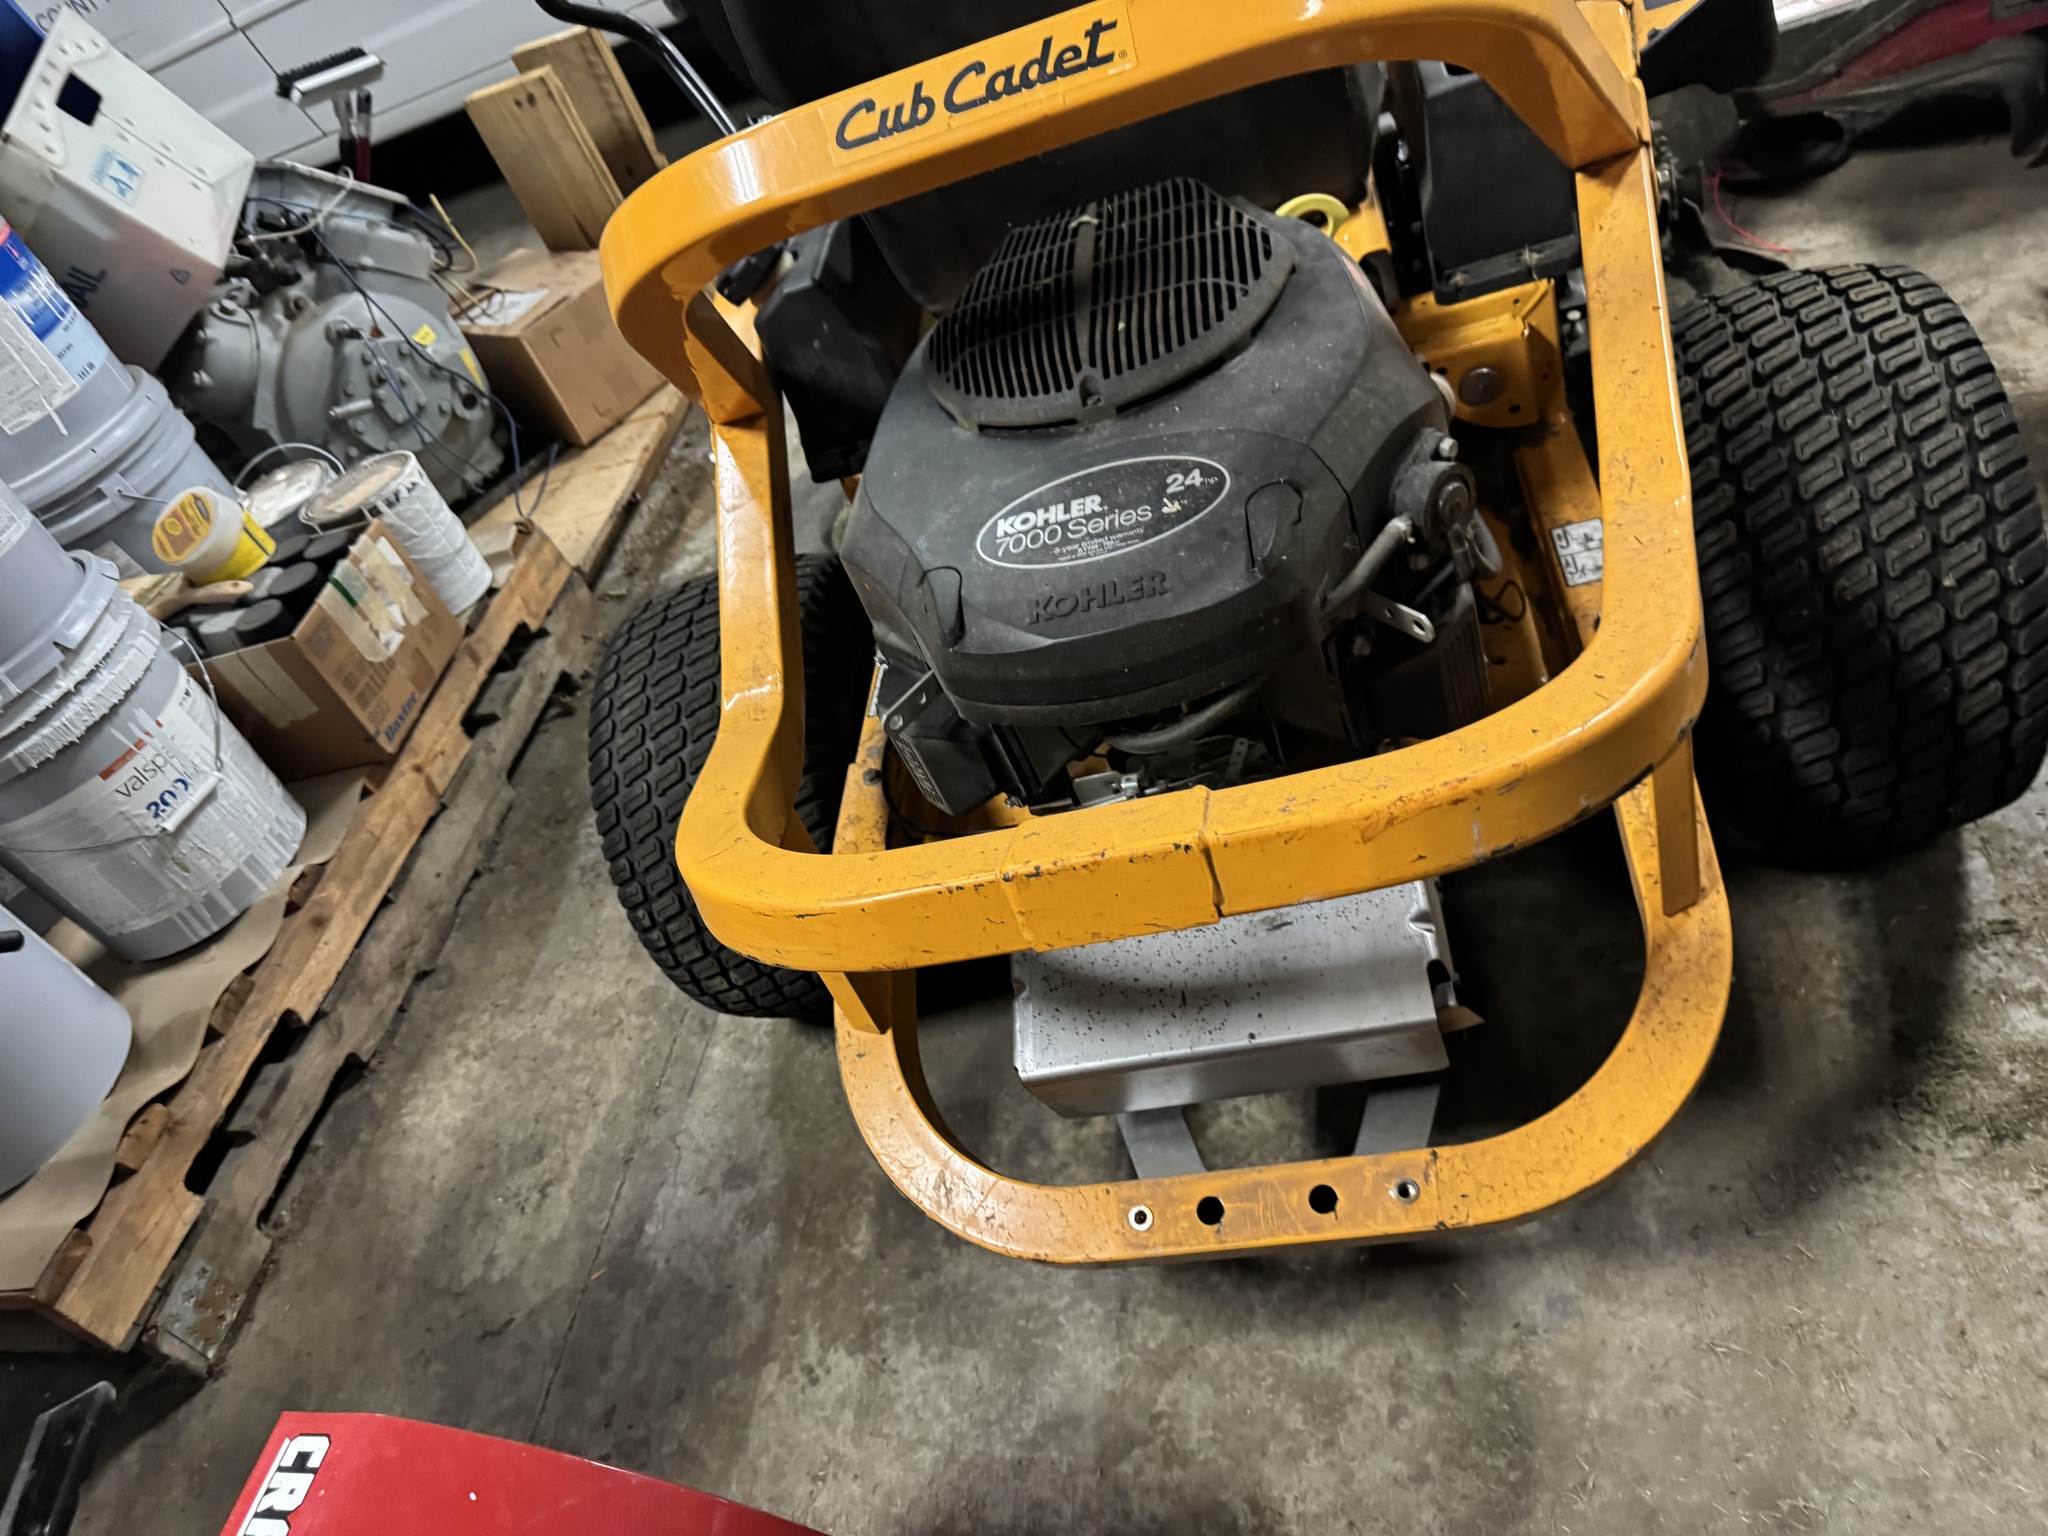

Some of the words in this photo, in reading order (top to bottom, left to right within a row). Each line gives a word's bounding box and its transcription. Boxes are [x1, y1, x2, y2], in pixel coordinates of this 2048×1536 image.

[836, 80, 936, 151] Cub
[943, 18, 1119, 115] Cadet
[1165, 467, 1203, 494] 24
[995, 493, 1104, 539] KOHLER
[995, 523, 1063, 558] 7000
[1066, 504, 1153, 541] Series
[1027, 570, 1170, 626] KOHLER
